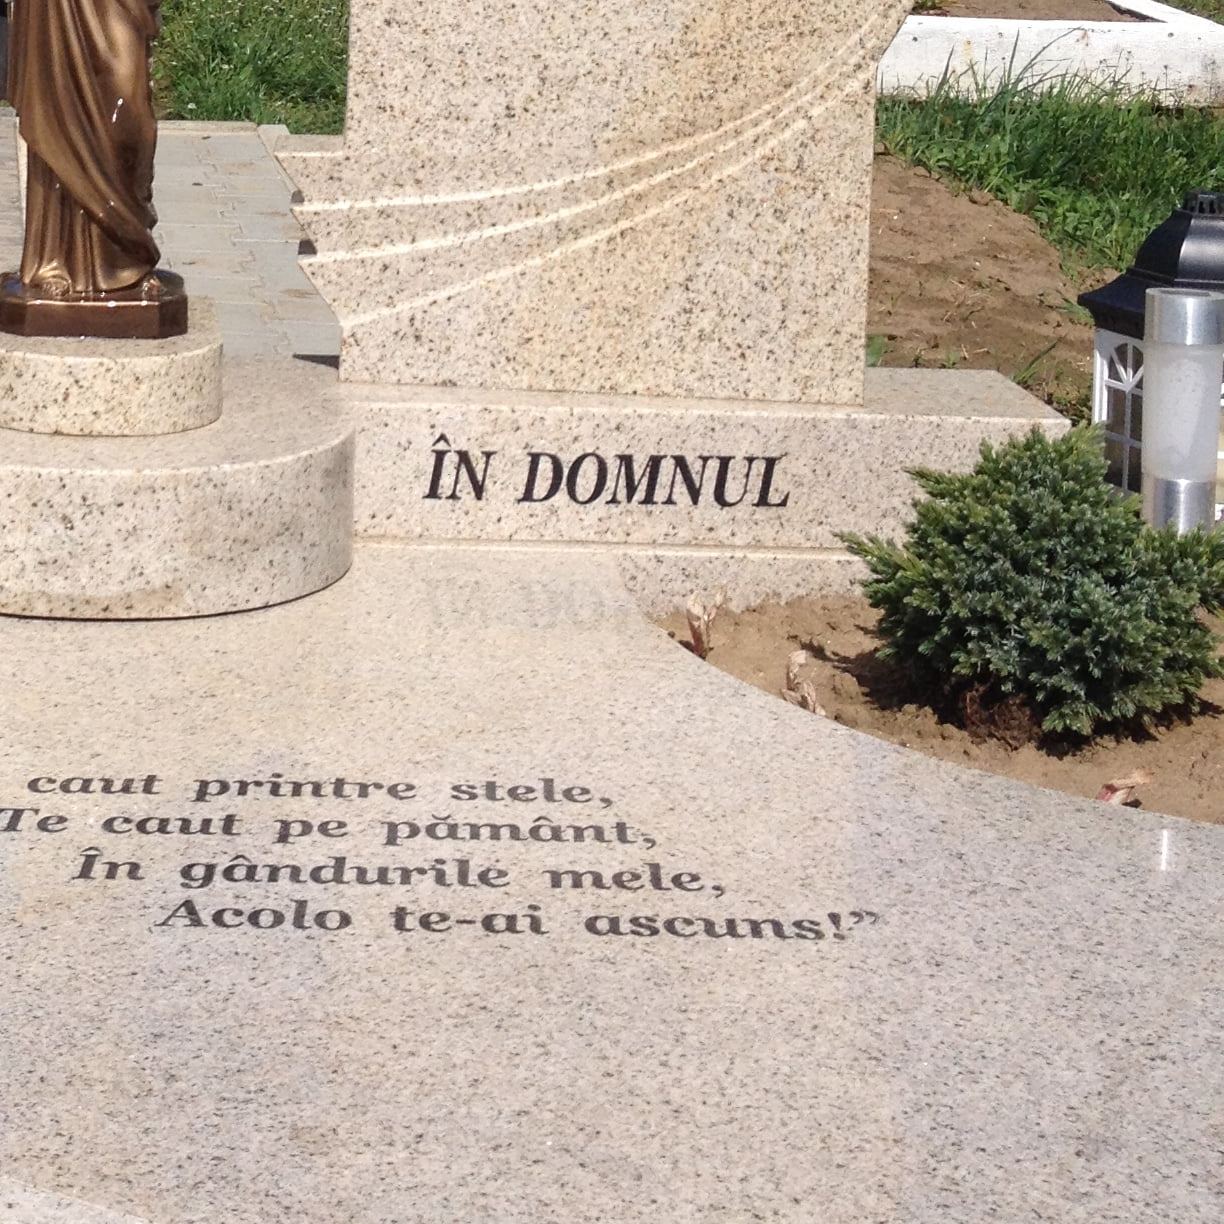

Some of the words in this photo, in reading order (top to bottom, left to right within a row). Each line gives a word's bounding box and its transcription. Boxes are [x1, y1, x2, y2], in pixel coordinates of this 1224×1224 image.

[422, 432, 498, 501] ÎN
[517, 451, 791, 508] DOMNUL
[26, 774, 163, 796] caut
[191, 772, 418, 803] printre
[450, 777, 613, 810] stele,
[102, 813, 244, 836] caut
[273, 817, 350, 845] pe
[380, 814, 658, 850] pământ,
[72, 846, 145, 881] În
[179, 853, 511, 890] gândurile
[542, 862, 726, 898] mele,
[154, 899, 353, 932] Acolo
[389, 904, 551, 935] te-ai
